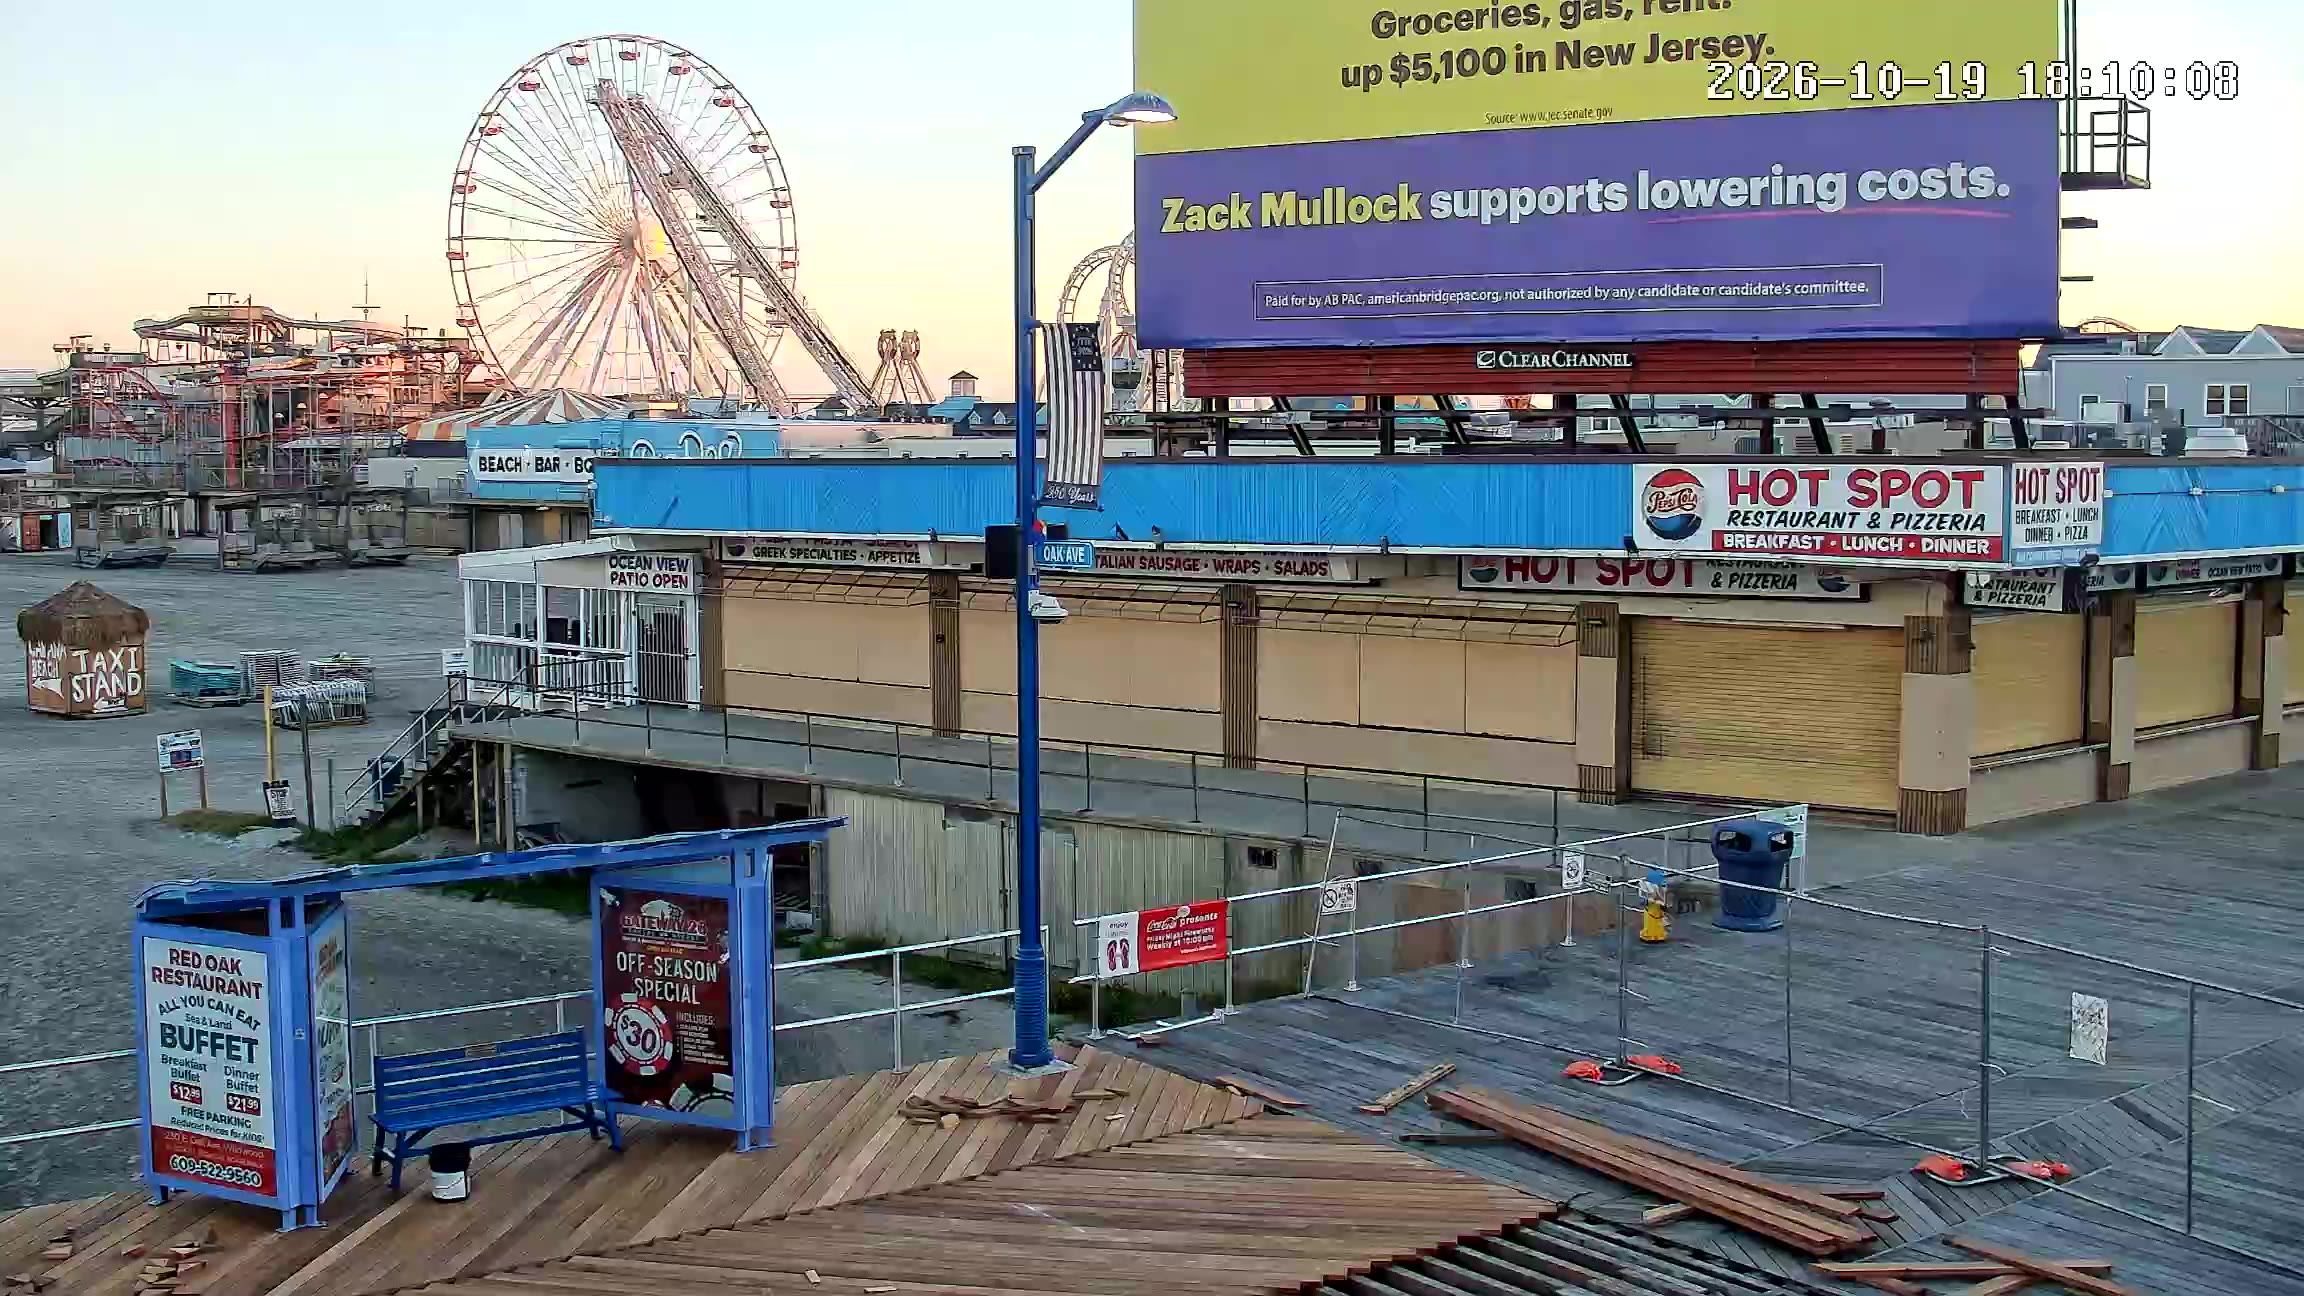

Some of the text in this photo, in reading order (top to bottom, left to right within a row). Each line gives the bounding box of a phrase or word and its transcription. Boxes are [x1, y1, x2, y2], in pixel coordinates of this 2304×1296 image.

[1371, 0, 1552, 38] Groceries,
[1560, 0, 1633, 29] gas,
[1341, 32, 1776, 92] up $5,100 in New Jersey.
[1161, 161, 2011, 233] Zack Mullock supports lowering costs.
[1265, 280, 1869, 309] Paid for by AB PAC, americanbridgepac.org, not authorized by any candidate or candidate's committee.
[479, 456, 522, 473] BEACH
[535, 456, 560, 473] BAR
[1728, 469, 1985, 508] HOT SPOT
[2015, 467, 2100, 504] HOT SPOT
[1727, 510, 1986, 532] RESTAURANT & PIZZERIA
[2015, 507, 2099, 524] BREAKFAST LUNCH
[1723, 533, 1991, 555] BREAKFAST LUNCH DINNER
[2025, 525, 2088, 542] DINNER PIZZA
[609, 555, 690, 573] OCEAN VIEW
[752, 546, 787, 559] GREEK
[789, 547, 857, 562] SPECIALTIES
[1043, 545, 1064, 562] OAK
[1066, 546, 1085, 563] AVE
[1139, 556, 1200, 572] SAUSAGE
[1212, 558, 1260, 575] WRAPS
[1274, 558, 1328, 576] SALADS
[1504, 557, 1576, 585] HOT
[610, 571, 689, 589] PATIO OPEN
[1728, 571, 1798, 590] PIZZERIA
[1987, 591, 2047, 607] PIZZERIA
[71, 647, 139, 673] TAXI
[71, 671, 142, 703] STAND
[168, 948, 243, 976] RED OAK
[616, 951, 718, 983] OFF-SEASON
[151, 967, 263, 1000] RESTAURANT
[634, 978, 701, 1005] SPECIAL
[158, 995, 261, 1031] ALL YOU CAN EAT
[186, 1013, 232, 1030] Sea & Land
[160, 1022, 259, 1064] BUFFET
[161, 1053, 207, 1072] Breakfast
[224, 1065, 260, 1081] Dinner
[170, 1068, 200, 1082] Buffet
[226, 1079, 260, 1093] Buffet
[181, 1105, 252, 1129] FREE PARKING
